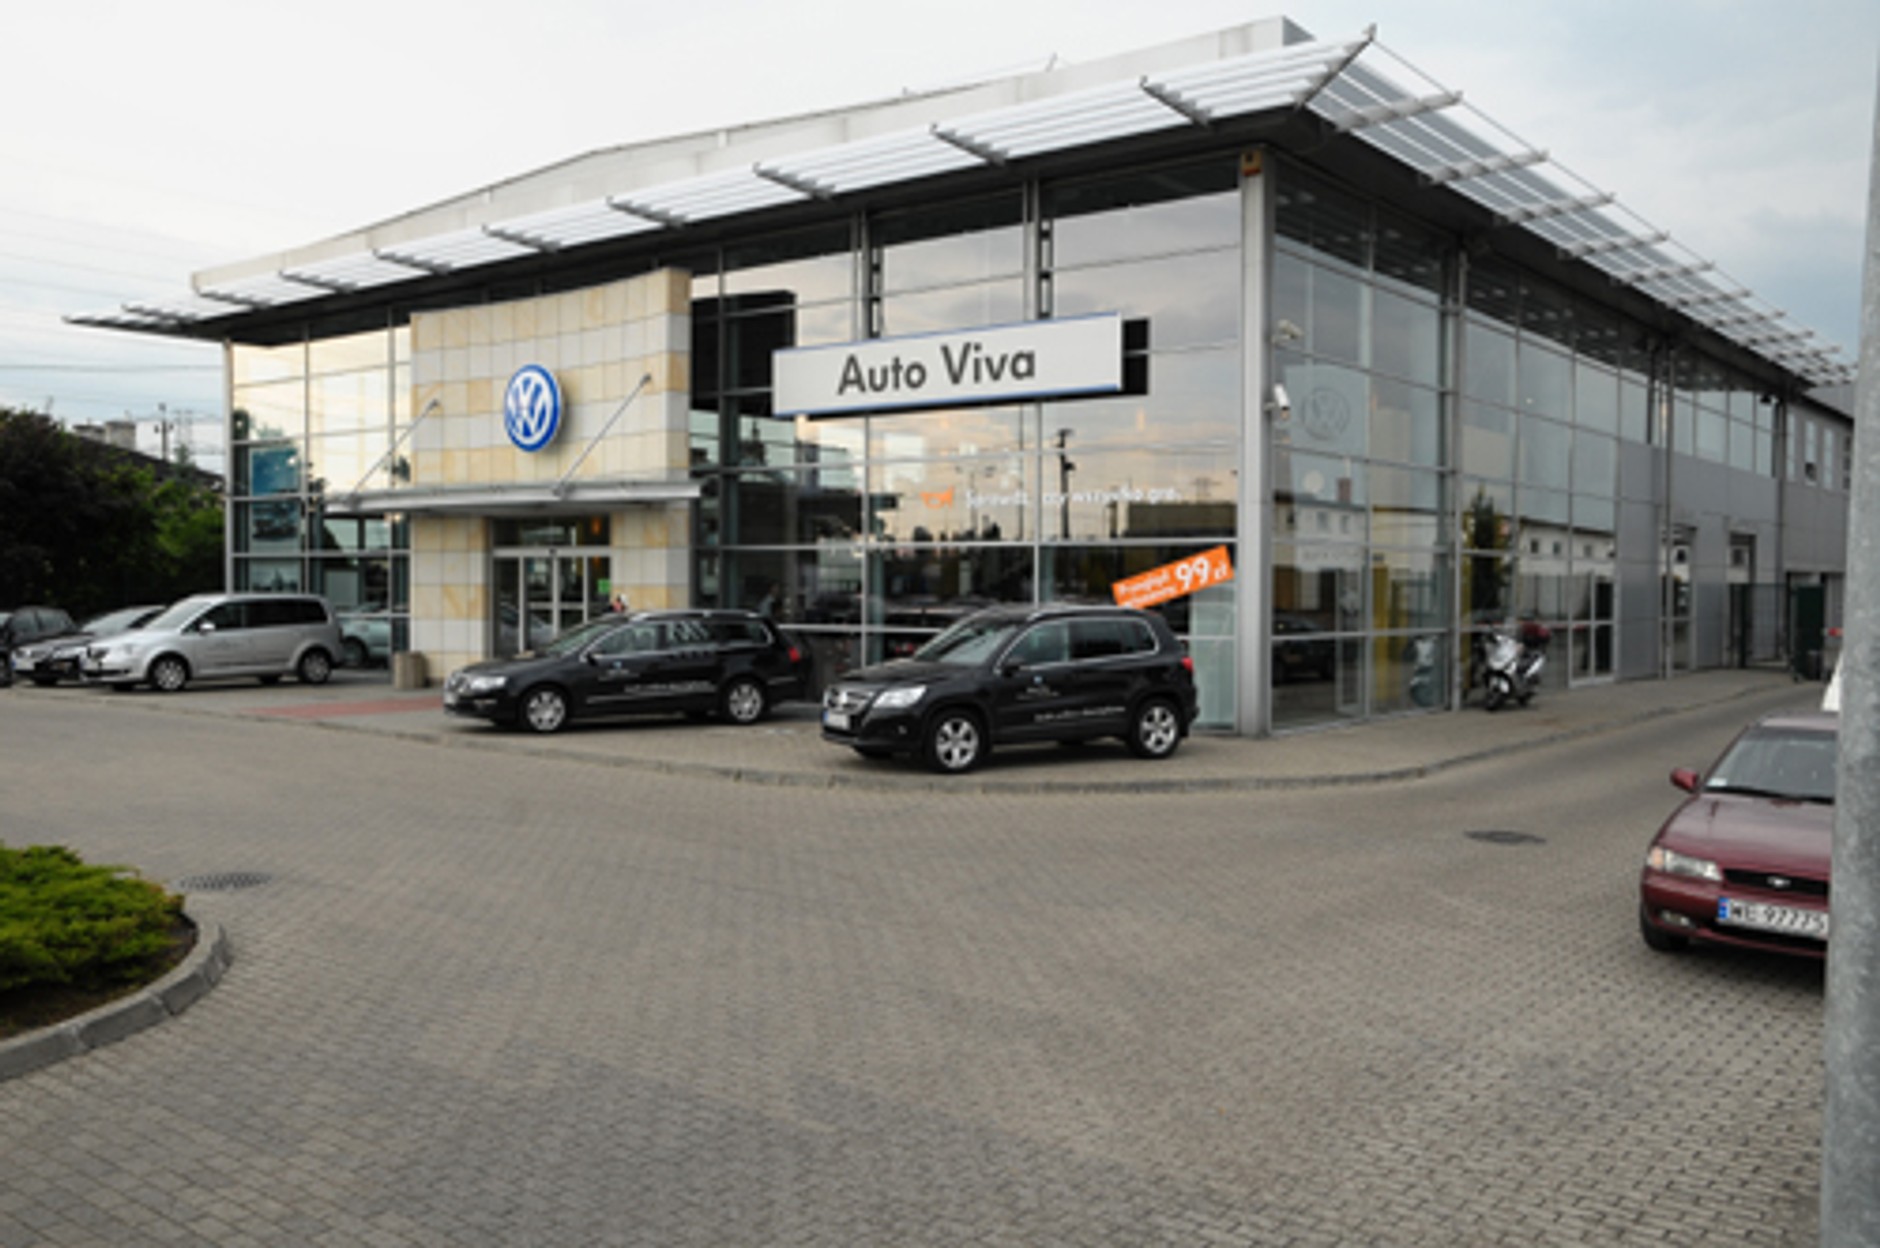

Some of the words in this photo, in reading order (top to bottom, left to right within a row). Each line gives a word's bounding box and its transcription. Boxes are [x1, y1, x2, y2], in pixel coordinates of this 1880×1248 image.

[837, 352, 927, 396] Auto
[940, 342, 1036, 385] Viva
[1175, 556, 1210, 590] 99
